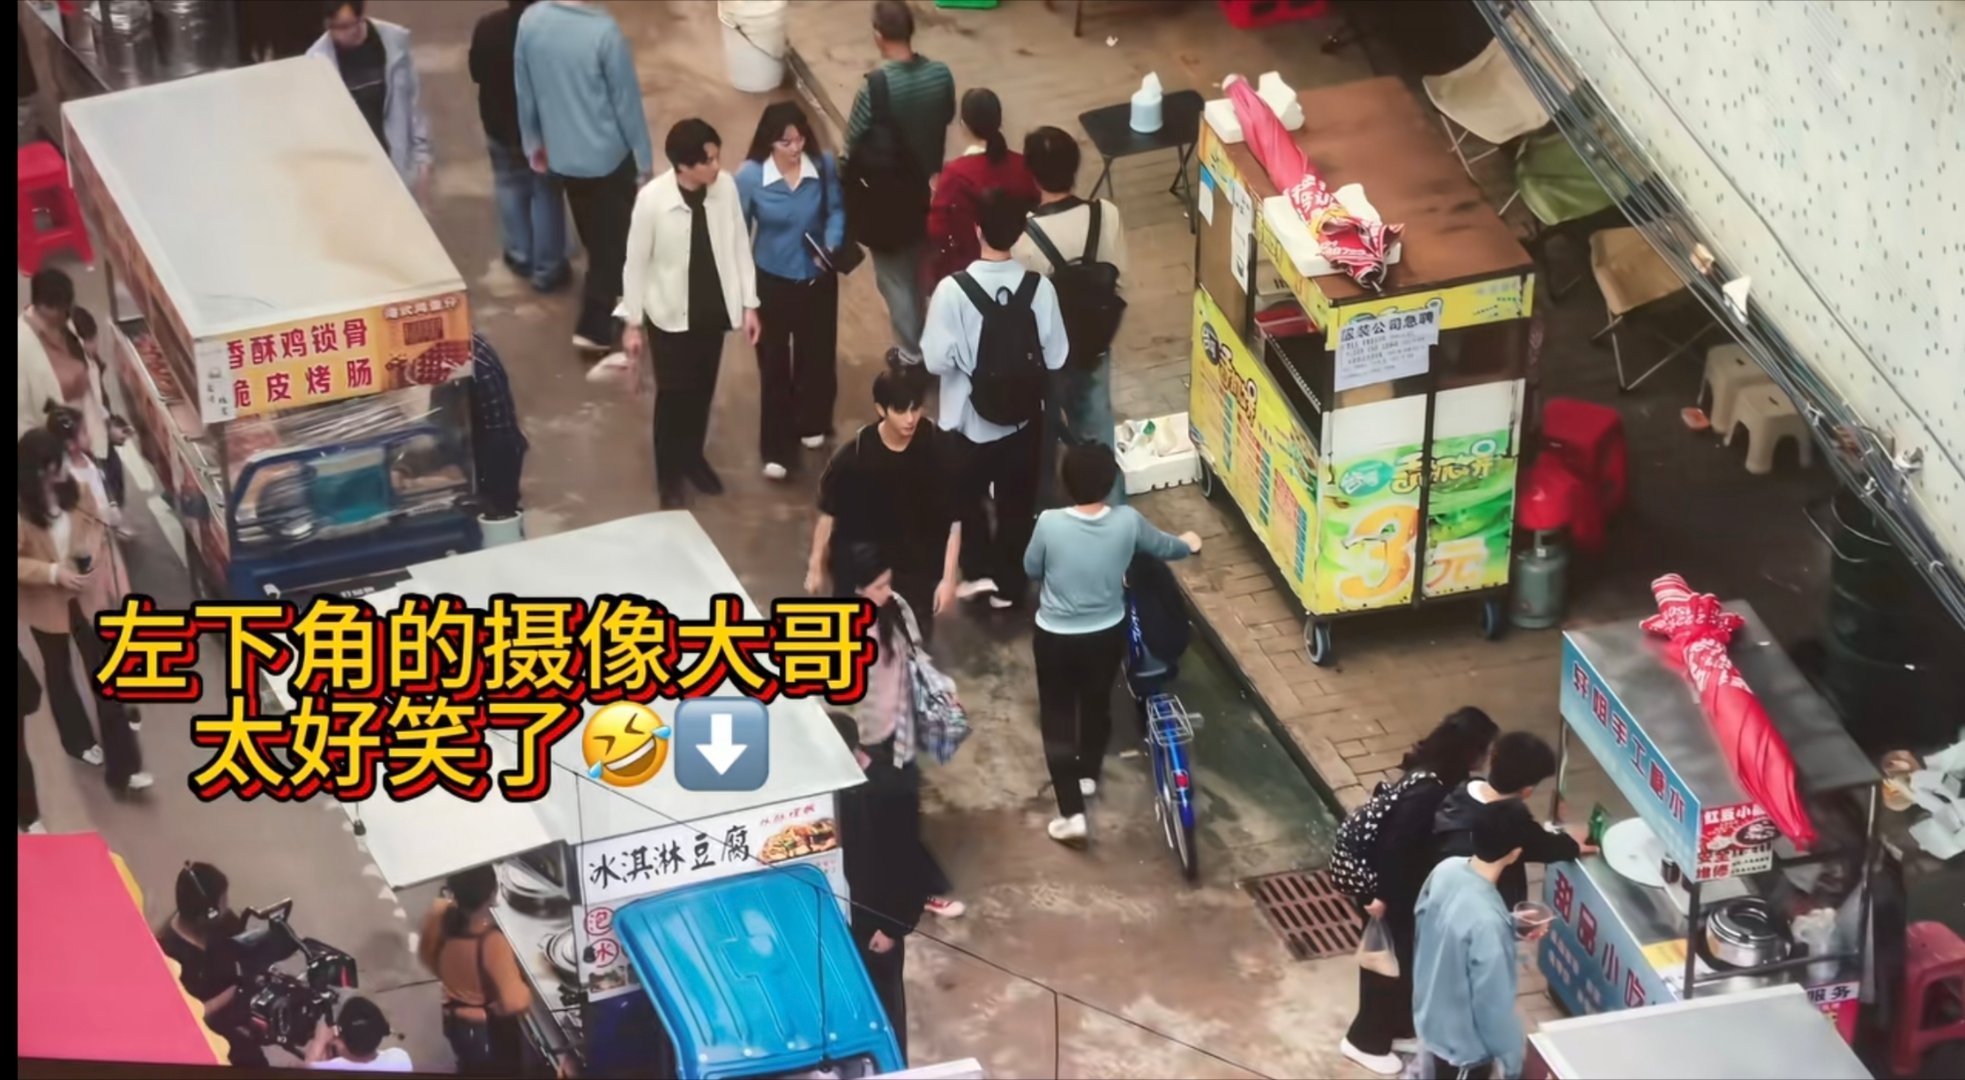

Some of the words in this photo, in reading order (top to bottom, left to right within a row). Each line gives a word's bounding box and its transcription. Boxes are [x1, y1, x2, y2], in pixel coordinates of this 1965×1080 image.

[226, 317, 369, 370] 香酥鸡锁骨
[589, 825, 750, 889] 冰淇淋豆腐
[1553, 869, 1647, 1010] 甜品小吃
